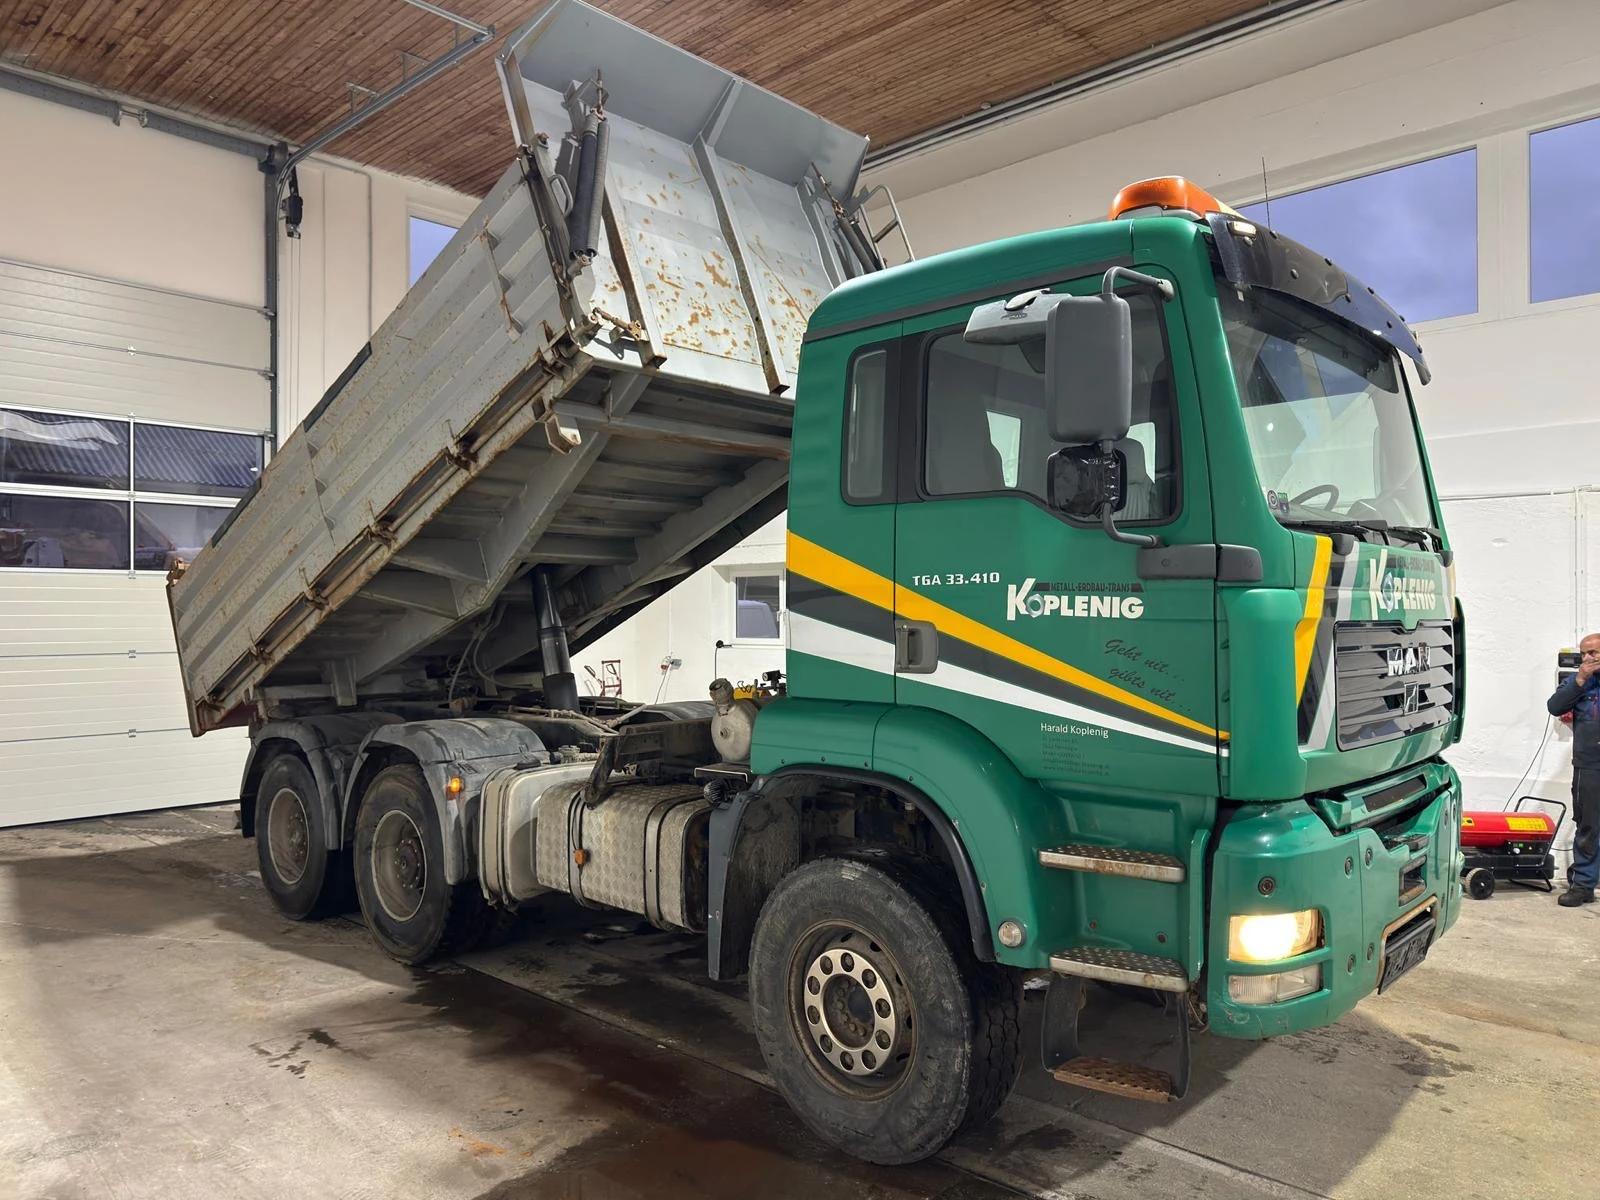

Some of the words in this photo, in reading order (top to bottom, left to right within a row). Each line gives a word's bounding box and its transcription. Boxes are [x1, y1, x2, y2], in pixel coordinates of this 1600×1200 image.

[912, 574, 942, 586] TGA
[945, 571, 1000, 585] 33.410
[1006, 577, 1144, 621] KOPLENIG
[1104, 638, 1143, 661] Geht
[1386, 645, 1431, 677] MAN
[1040, 722, 1069, 734] Harald
[1070, 725, 1109, 739] Koplenig
